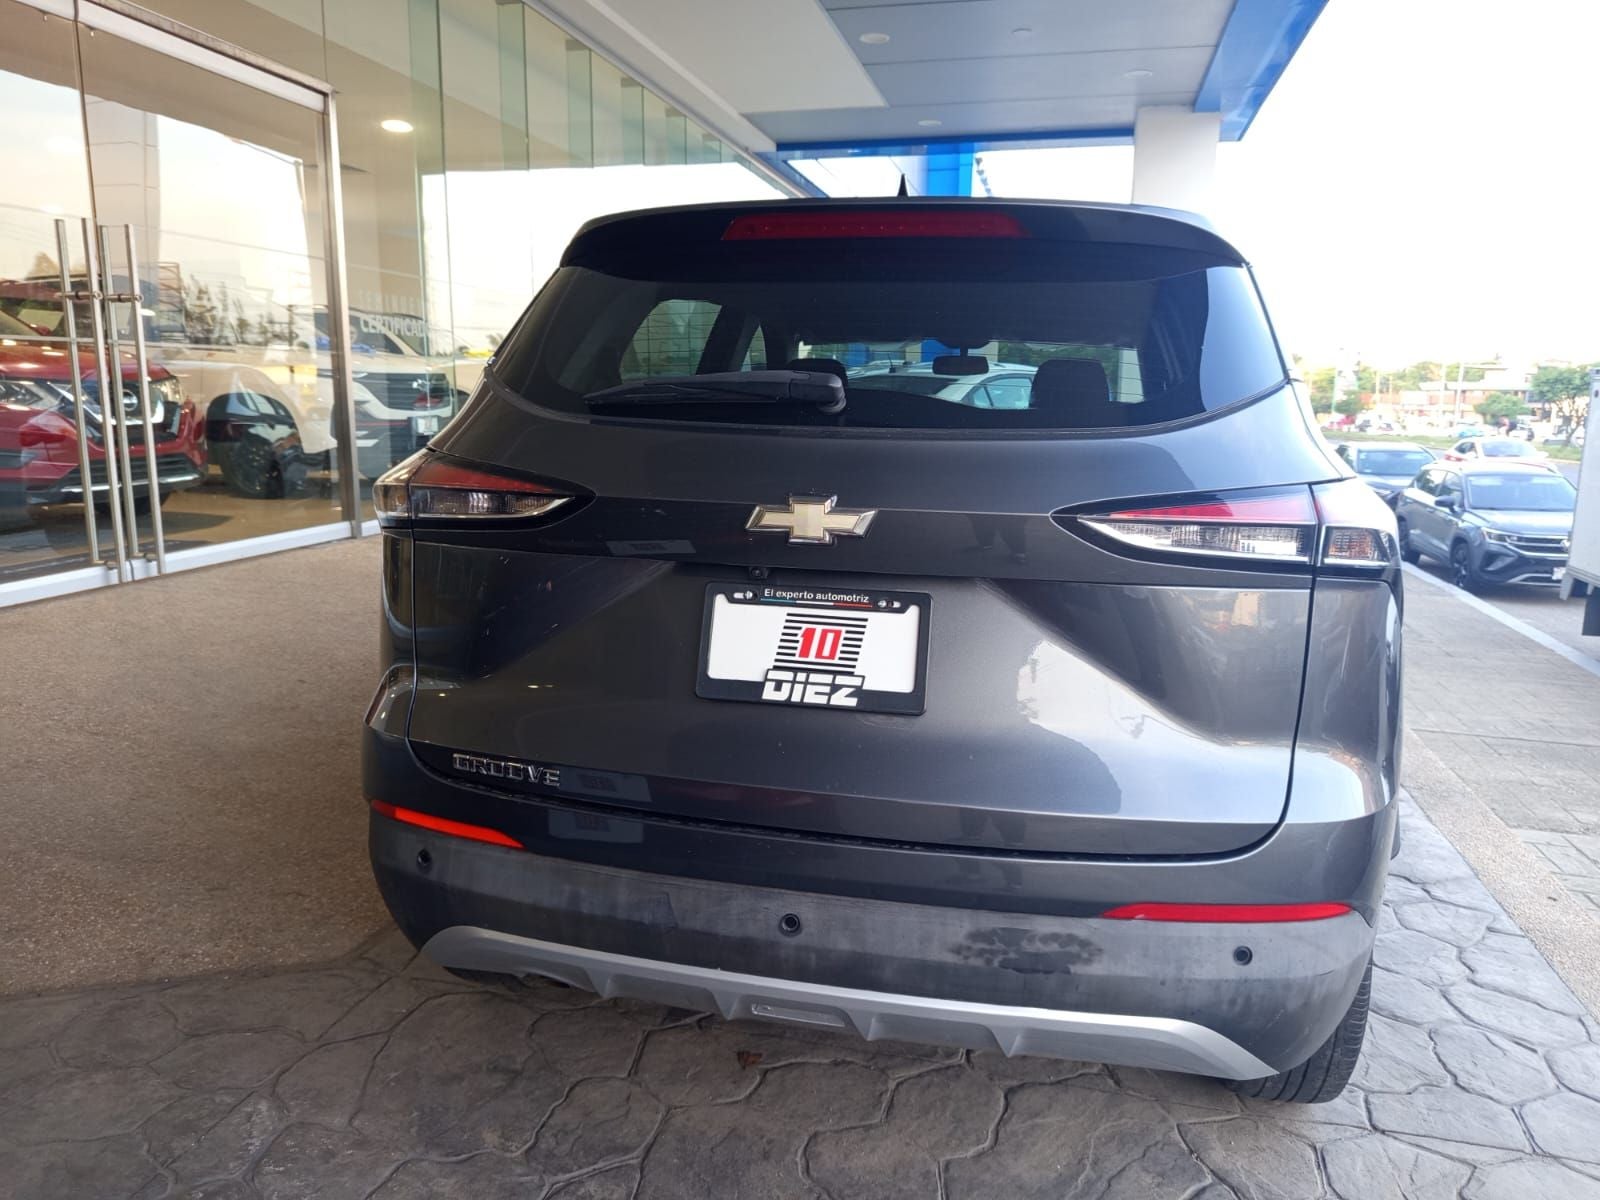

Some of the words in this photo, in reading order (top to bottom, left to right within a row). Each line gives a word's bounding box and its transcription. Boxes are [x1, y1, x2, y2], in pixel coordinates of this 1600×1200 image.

[764, 588, 774, 597] El
[776, 590, 814, 600] experto
[815, 592, 870, 603] automotriz
[798, 627, 842, 660] 10
[761, 670, 863, 707] DIEZ
[452, 752, 561, 787] GROOVE
